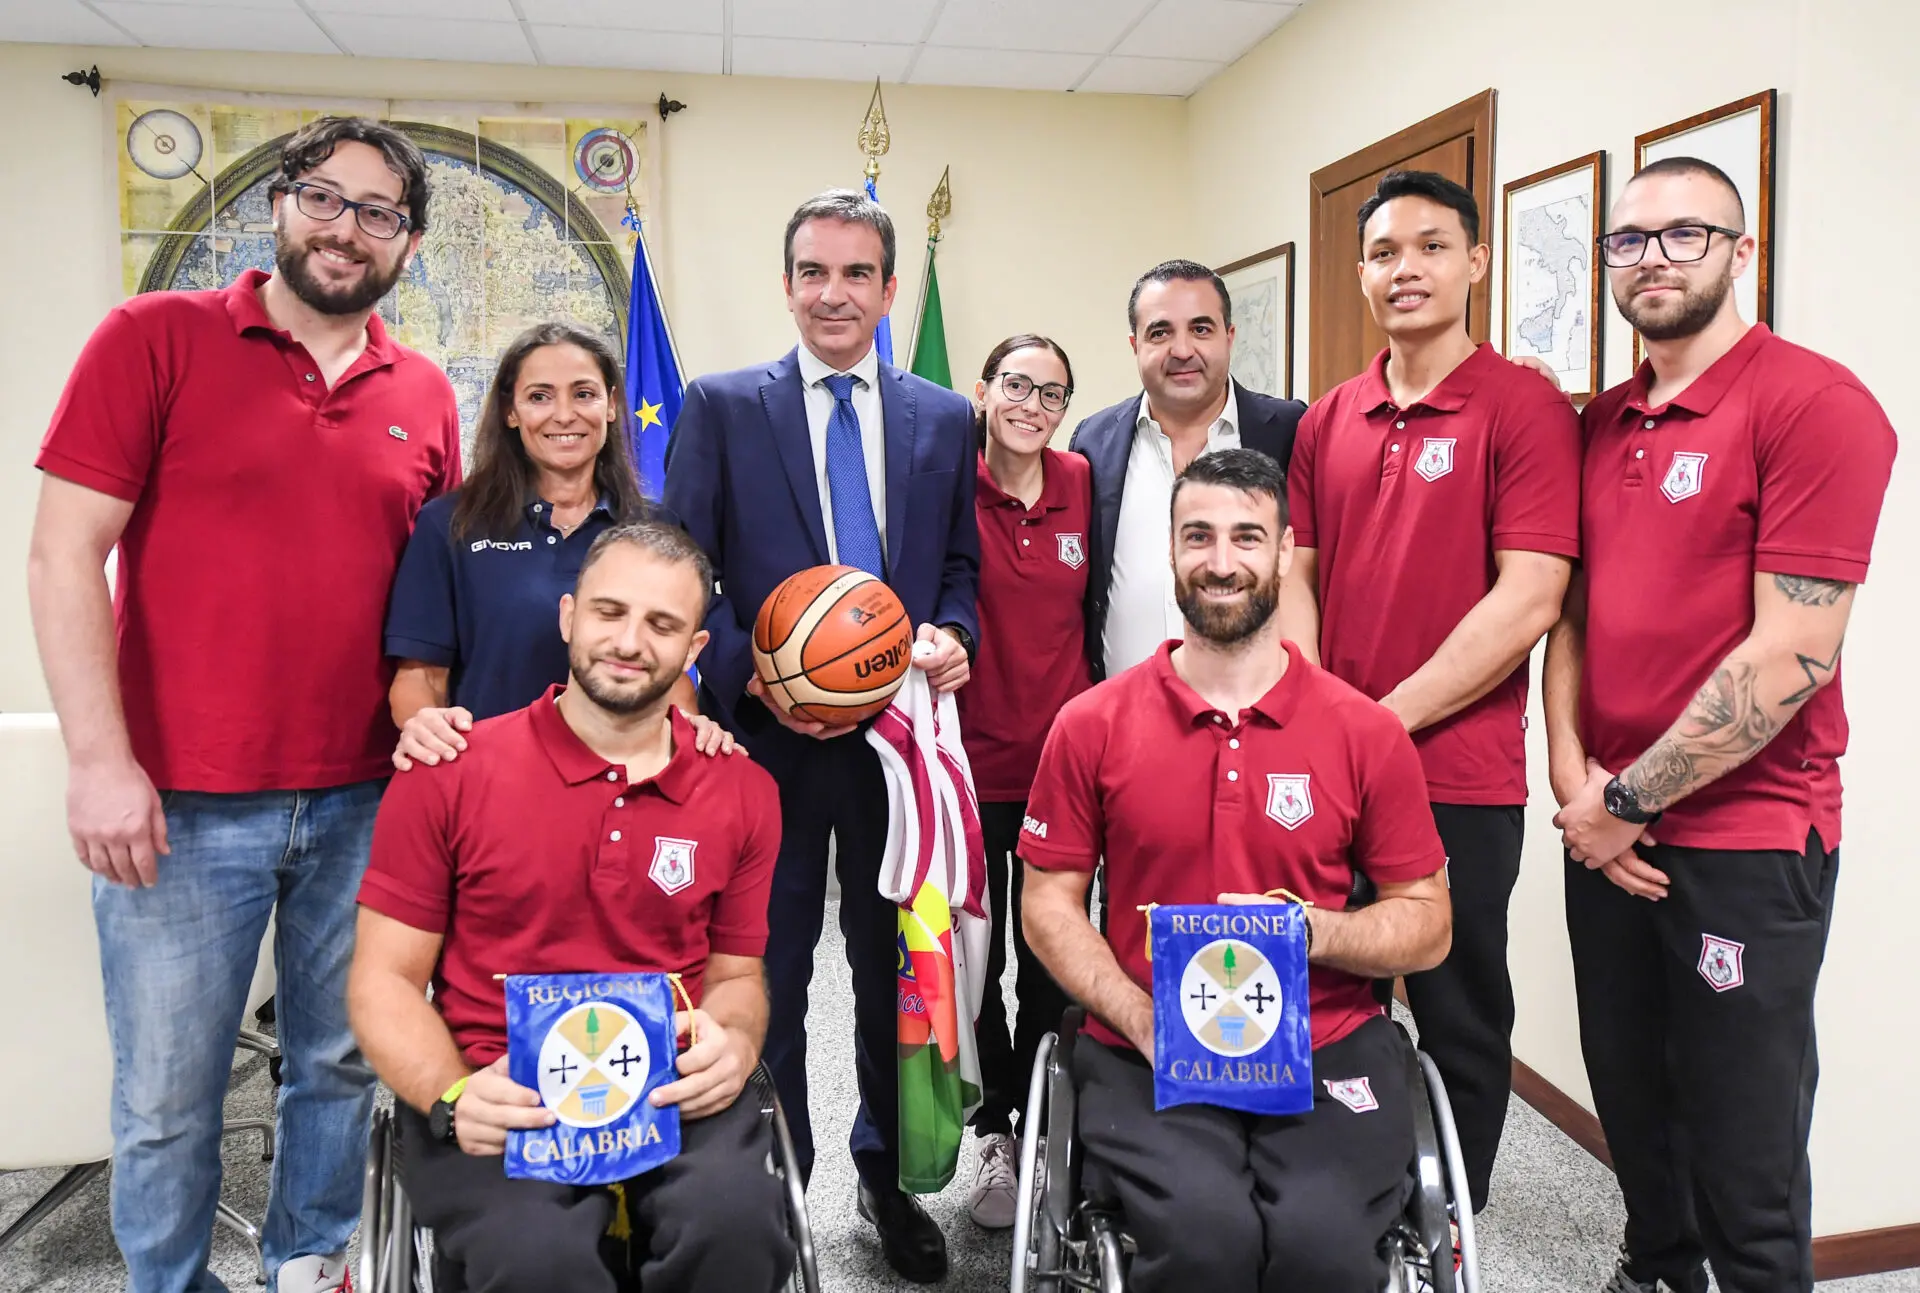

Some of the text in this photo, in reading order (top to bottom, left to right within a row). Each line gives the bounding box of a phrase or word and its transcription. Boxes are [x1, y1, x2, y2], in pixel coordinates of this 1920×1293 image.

[471, 539, 532, 552] GIVOVA
[1172, 914, 1286, 936] REGIONE
[1170, 1060, 1296, 1084] CALABRIA
[522, 1123, 662, 1164] CALABRIA
